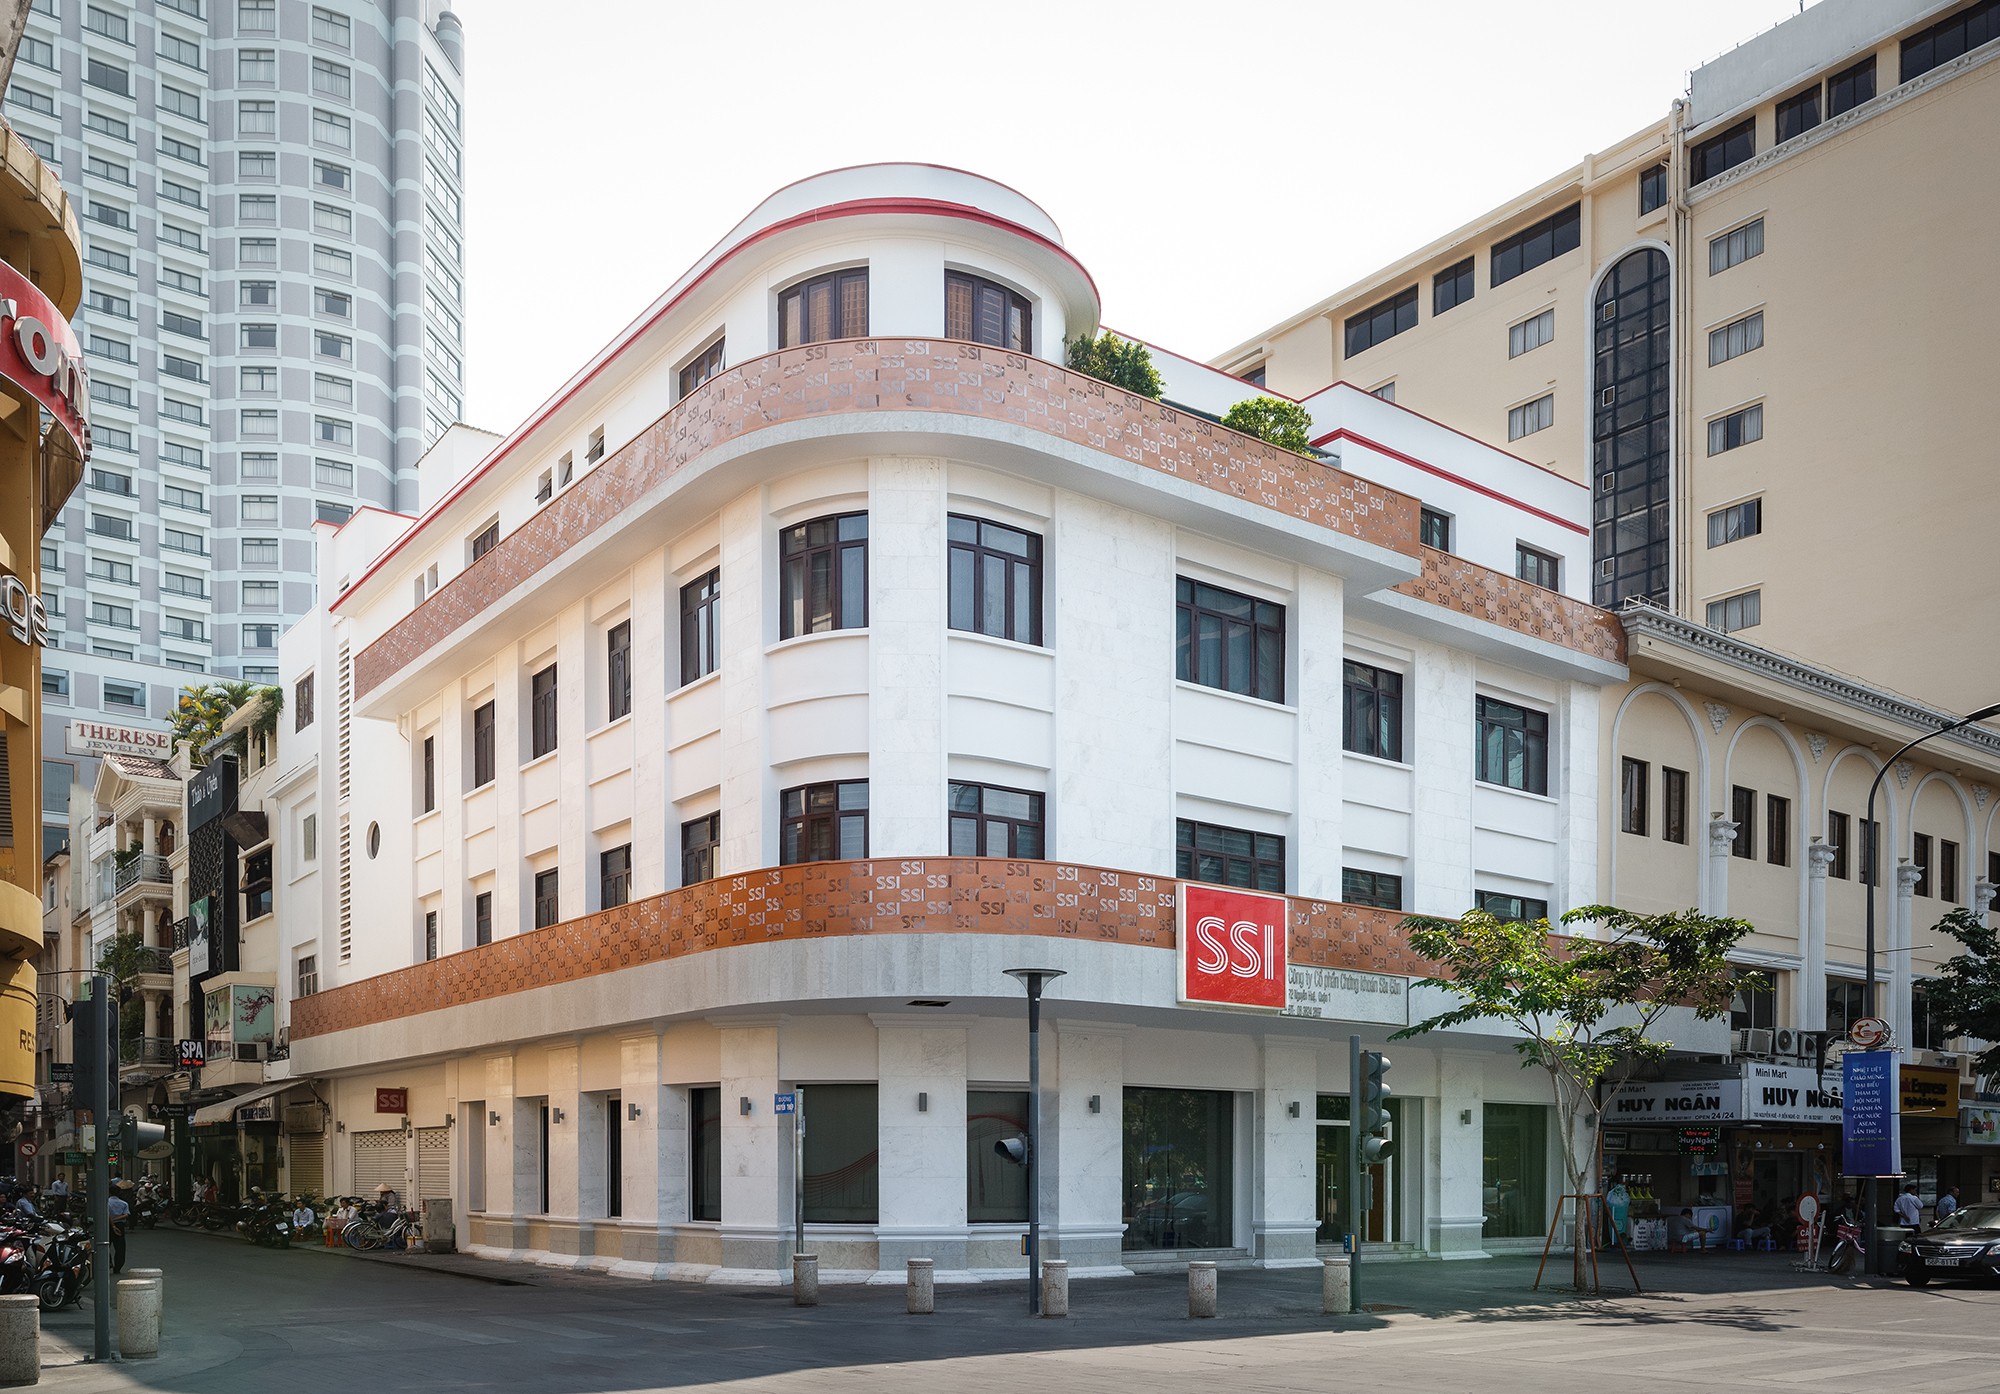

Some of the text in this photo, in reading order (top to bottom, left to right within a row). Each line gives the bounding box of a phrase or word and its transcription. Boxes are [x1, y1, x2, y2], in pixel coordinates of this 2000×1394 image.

[806, 346, 827, 361] SSI
[905, 341, 929, 355] SSI
[958, 346, 981, 360] SSI
[1006, 355, 1027, 371] SSI
[805, 373, 827, 387] SSI
[855, 369, 878, 382] SSI
[905, 368, 929, 381] SSI
[958, 372, 981, 386] SSI
[983, 388, 1004, 404] SSI
[1029, 399, 1047, 415] SSI
[1069, 413, 1087, 429] SSI
[1088, 432, 1105, 448] SSI
[1143, 438, 1160, 454] SSI
[1125, 445, 1142, 461] SSI
[76, 723, 168, 749] THERESE
[86, 740, 158, 756] JEWELRY
[901, 862, 925, 875] SSI
[1007, 863, 1029, 876] SSI
[1057, 867, 1078, 881] SSI
[733, 877, 746, 891] SSI
[766, 872, 783, 885] SSI
[876, 876, 900, 889] SSI
[927, 875, 952, 888] SSI
[1100, 872, 1118, 886] SSI
[1138, 878, 1155, 892] SSI
[749, 887, 765, 901] SSI
[901, 889, 925, 902] SSI
[1079, 883, 1098, 896] SSI
[1119, 888, 1137, 902] SSI
[719, 893, 731, 906] SSI
[766, 898, 783, 911] SSI
[1057, 893, 1078, 907] SSI
[1100, 899, 1118, 912] SSI
[1158, 894, 1174, 907] SSI
[733, 903, 746, 916] SSI
[876, 902, 900, 915] SSI
[927, 901, 952, 914] SSI
[981, 902, 1004, 915] SSI
[1033, 904, 1055, 918] SSI
[1138, 903, 1155, 917] SSI
[1311, 903, 1326, 915] SSI
[749, 912, 765, 926] SSI
[785, 908, 804, 922] SSI
[1295, 913, 1310, 925] SSI
[806, 920, 826, 932] SSI
[1311, 927, 1326, 939] SSI
[706, 933, 717, 946] SSI
[1196, 916, 1274, 980] SSI
[1288, 968, 1304, 988] Công
[1306, 970, 1313, 989] ty
[1314, 969, 1322, 987] Cổ
[1324, 971, 1339, 990] phần
[207, 994, 220, 1019] SPA
[182, 1041, 203, 1058] SPA
[1756, 1068, 1787, 1079] Mini Mart
[1867, 1080, 1879, 1088] BIỂU
[1912, 1078, 1947, 1096] Express
[379, 1094, 405, 1108] SSI
[1618, 1093, 1720, 1112] HUY NGÂN
[1763, 1087, 1798, 1106] HUY
[1680, 1137, 1695, 1145] Huy
[1695, 1137, 1716, 1145] Ngân
